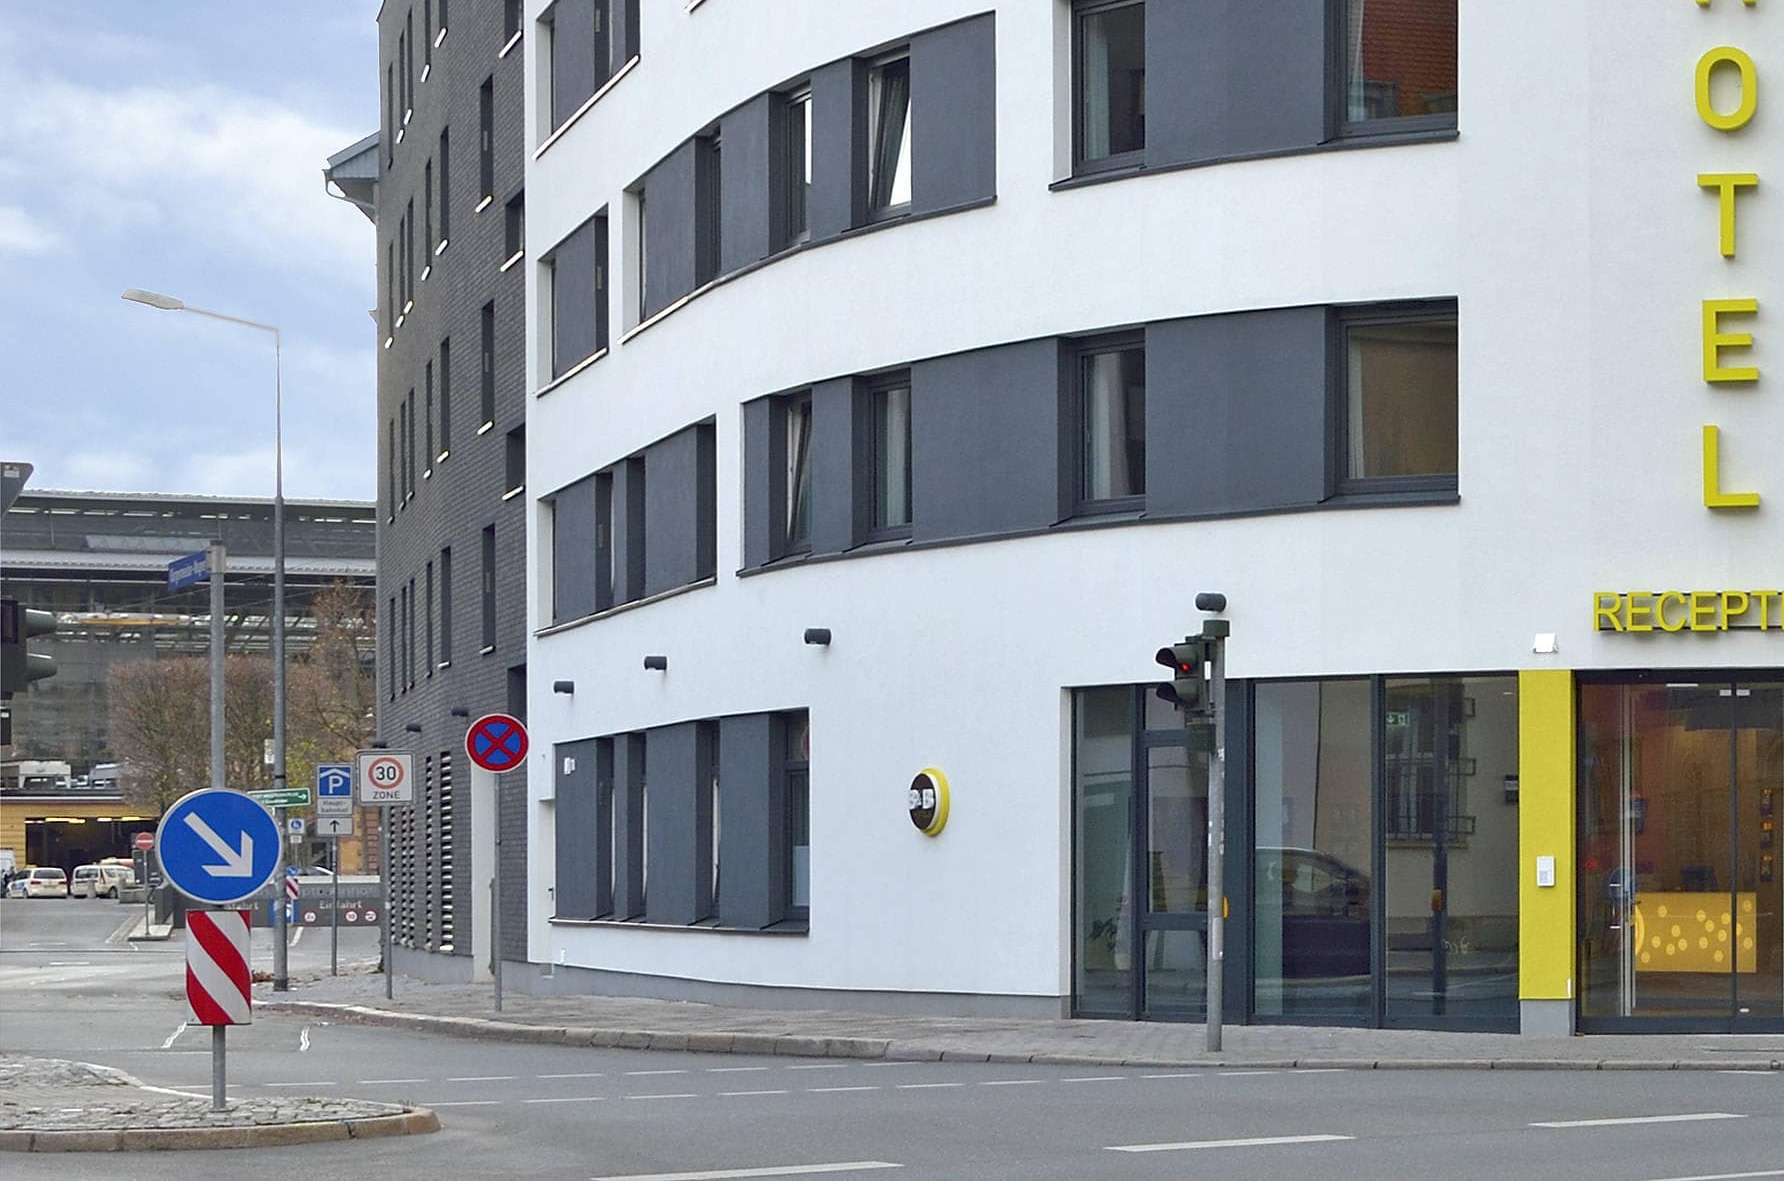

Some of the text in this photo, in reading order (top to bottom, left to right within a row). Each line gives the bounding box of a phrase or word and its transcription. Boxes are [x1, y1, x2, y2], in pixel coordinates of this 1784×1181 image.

[375, 765, 397, 781] 30
[328, 775, 344, 795] P
[372, 791, 401, 800] ZONE
